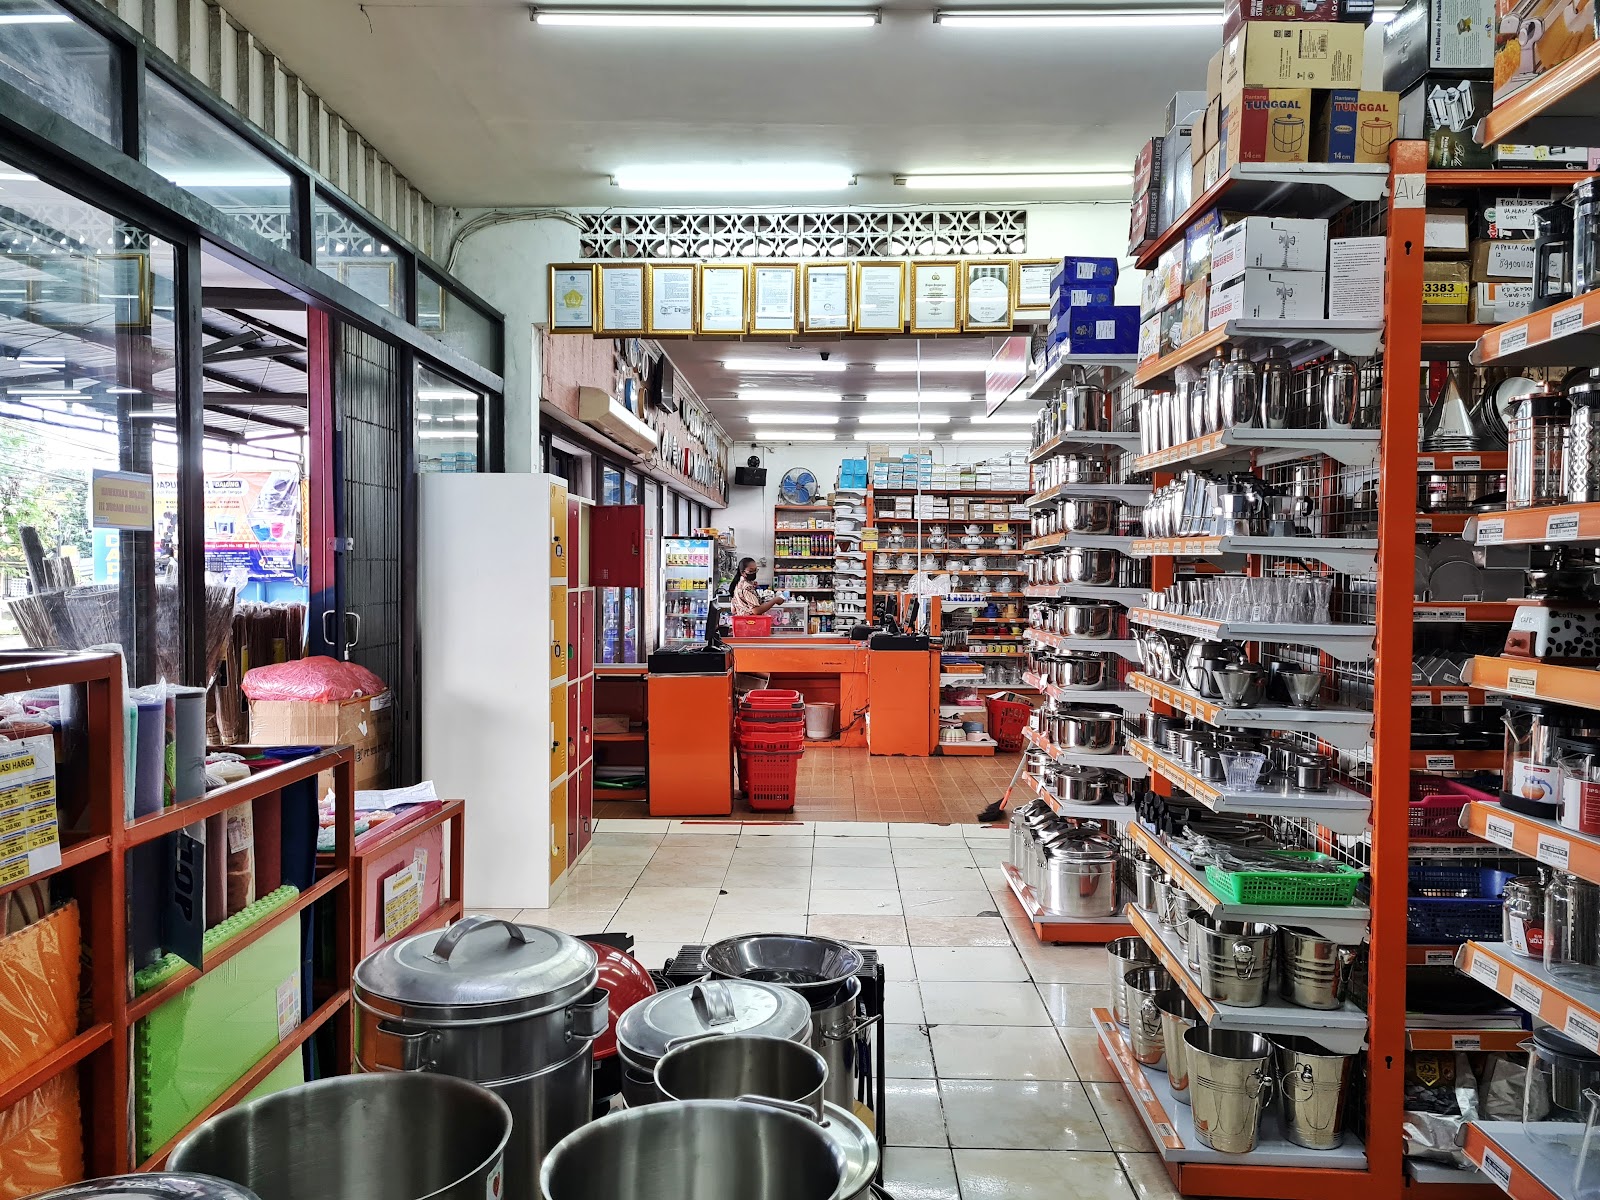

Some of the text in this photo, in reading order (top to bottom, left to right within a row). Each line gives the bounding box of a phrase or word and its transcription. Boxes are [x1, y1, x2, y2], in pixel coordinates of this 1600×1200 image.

[1244, 100, 1302, 110] TUNGGAL
[1334, 102, 1389, 112] TUNGGAL
[1153, 139, 1163, 181] PRESS JUICER
[1395, 177, 1426, 199] A14
[1422, 284, 1455, 293] 3383
[12, 758, 35, 770] HARGA
